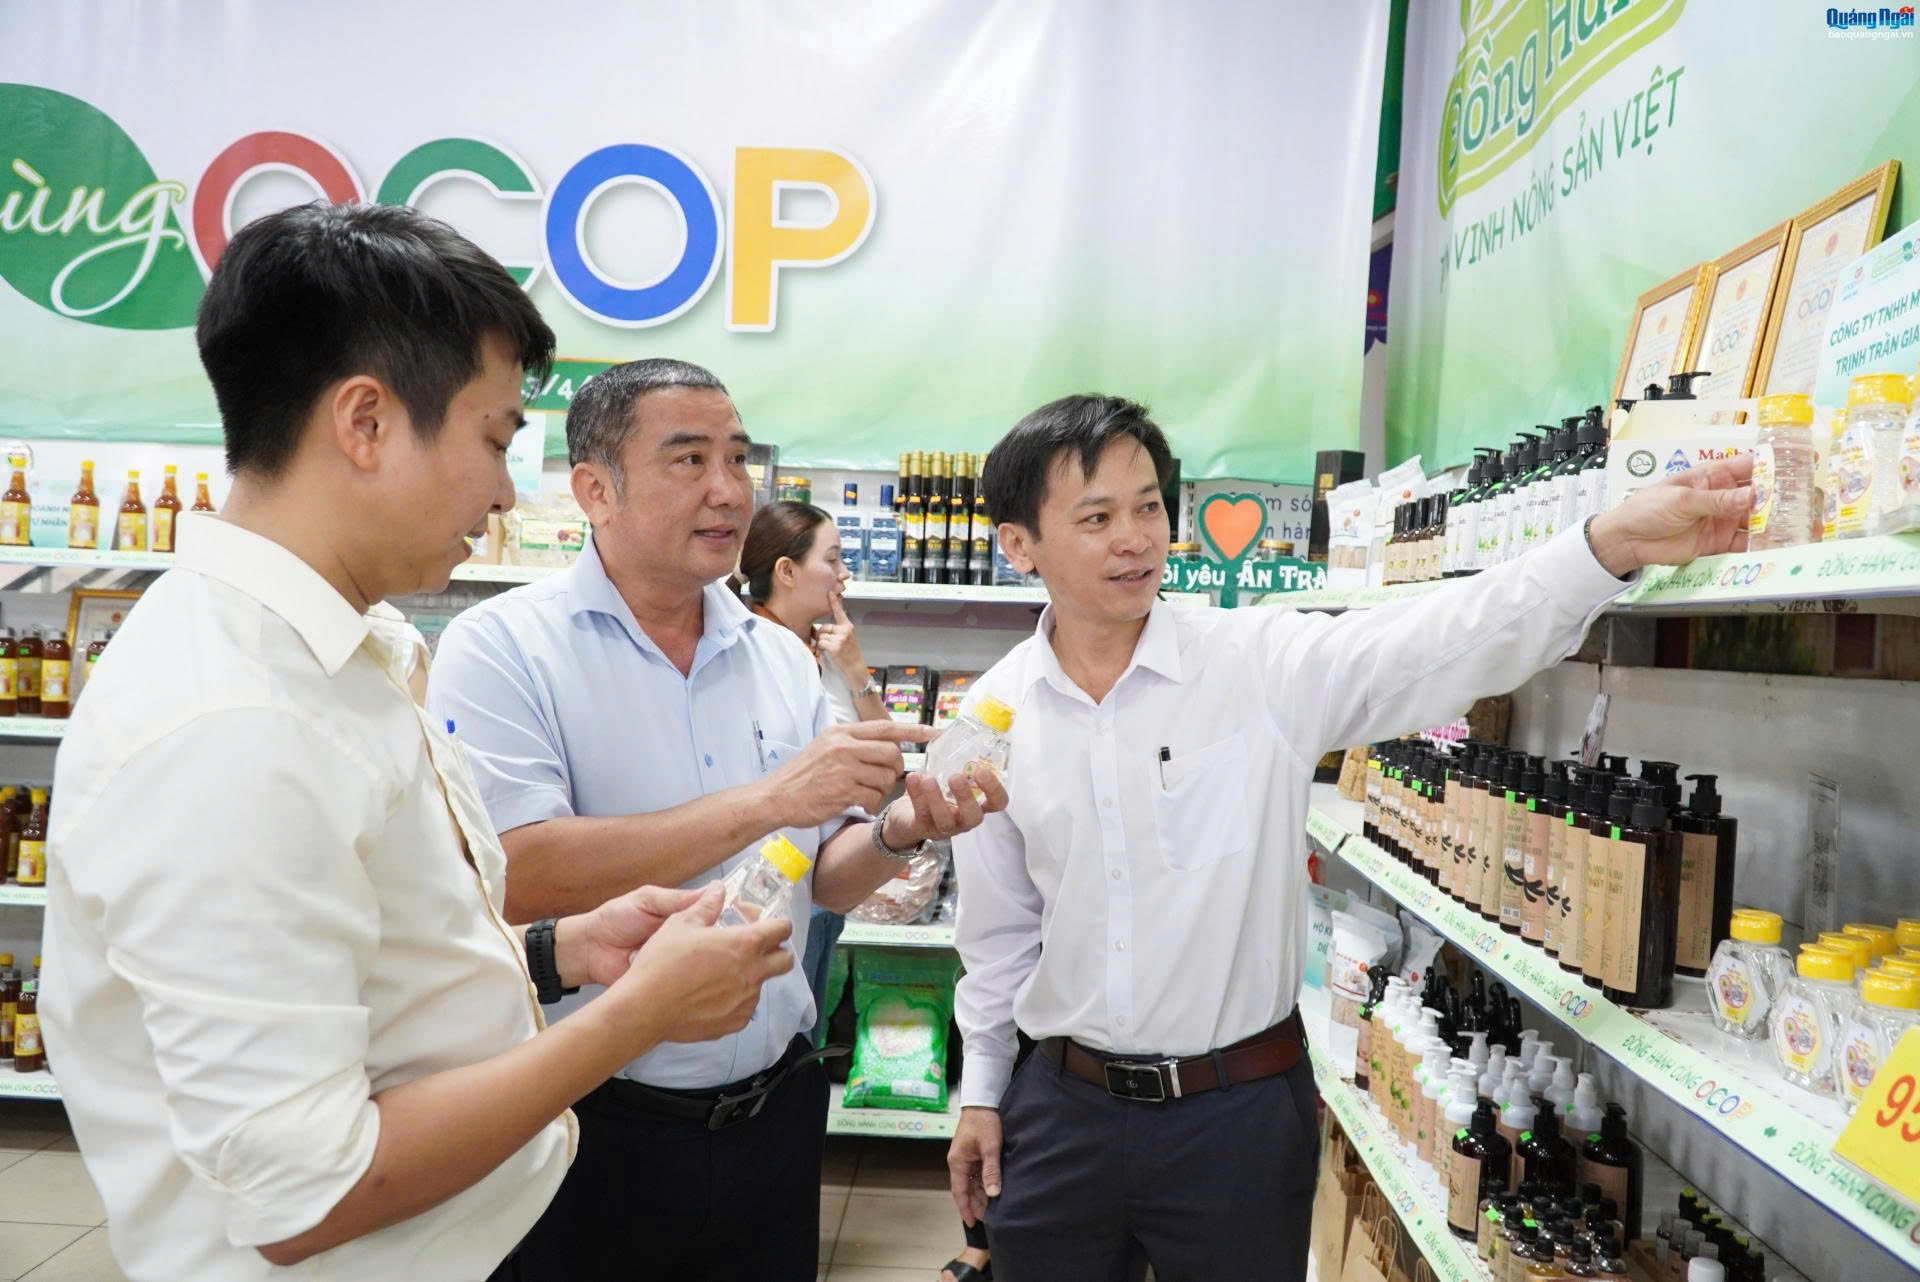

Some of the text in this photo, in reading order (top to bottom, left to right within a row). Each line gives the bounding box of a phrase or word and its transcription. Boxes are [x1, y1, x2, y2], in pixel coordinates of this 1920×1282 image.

[1454, 206, 1505, 270] VINH
[1511, 162, 1554, 242] NÔNG
[1561, 110, 1605, 197] SẢN
[1614, 65, 1685, 158] VIỆT
[1830, 322, 1860, 346] CÔNG
[1862, 312, 1876, 333] TY
[1878, 294, 1909, 326] TNHH
[1186, 563, 1226, 590] yêu
